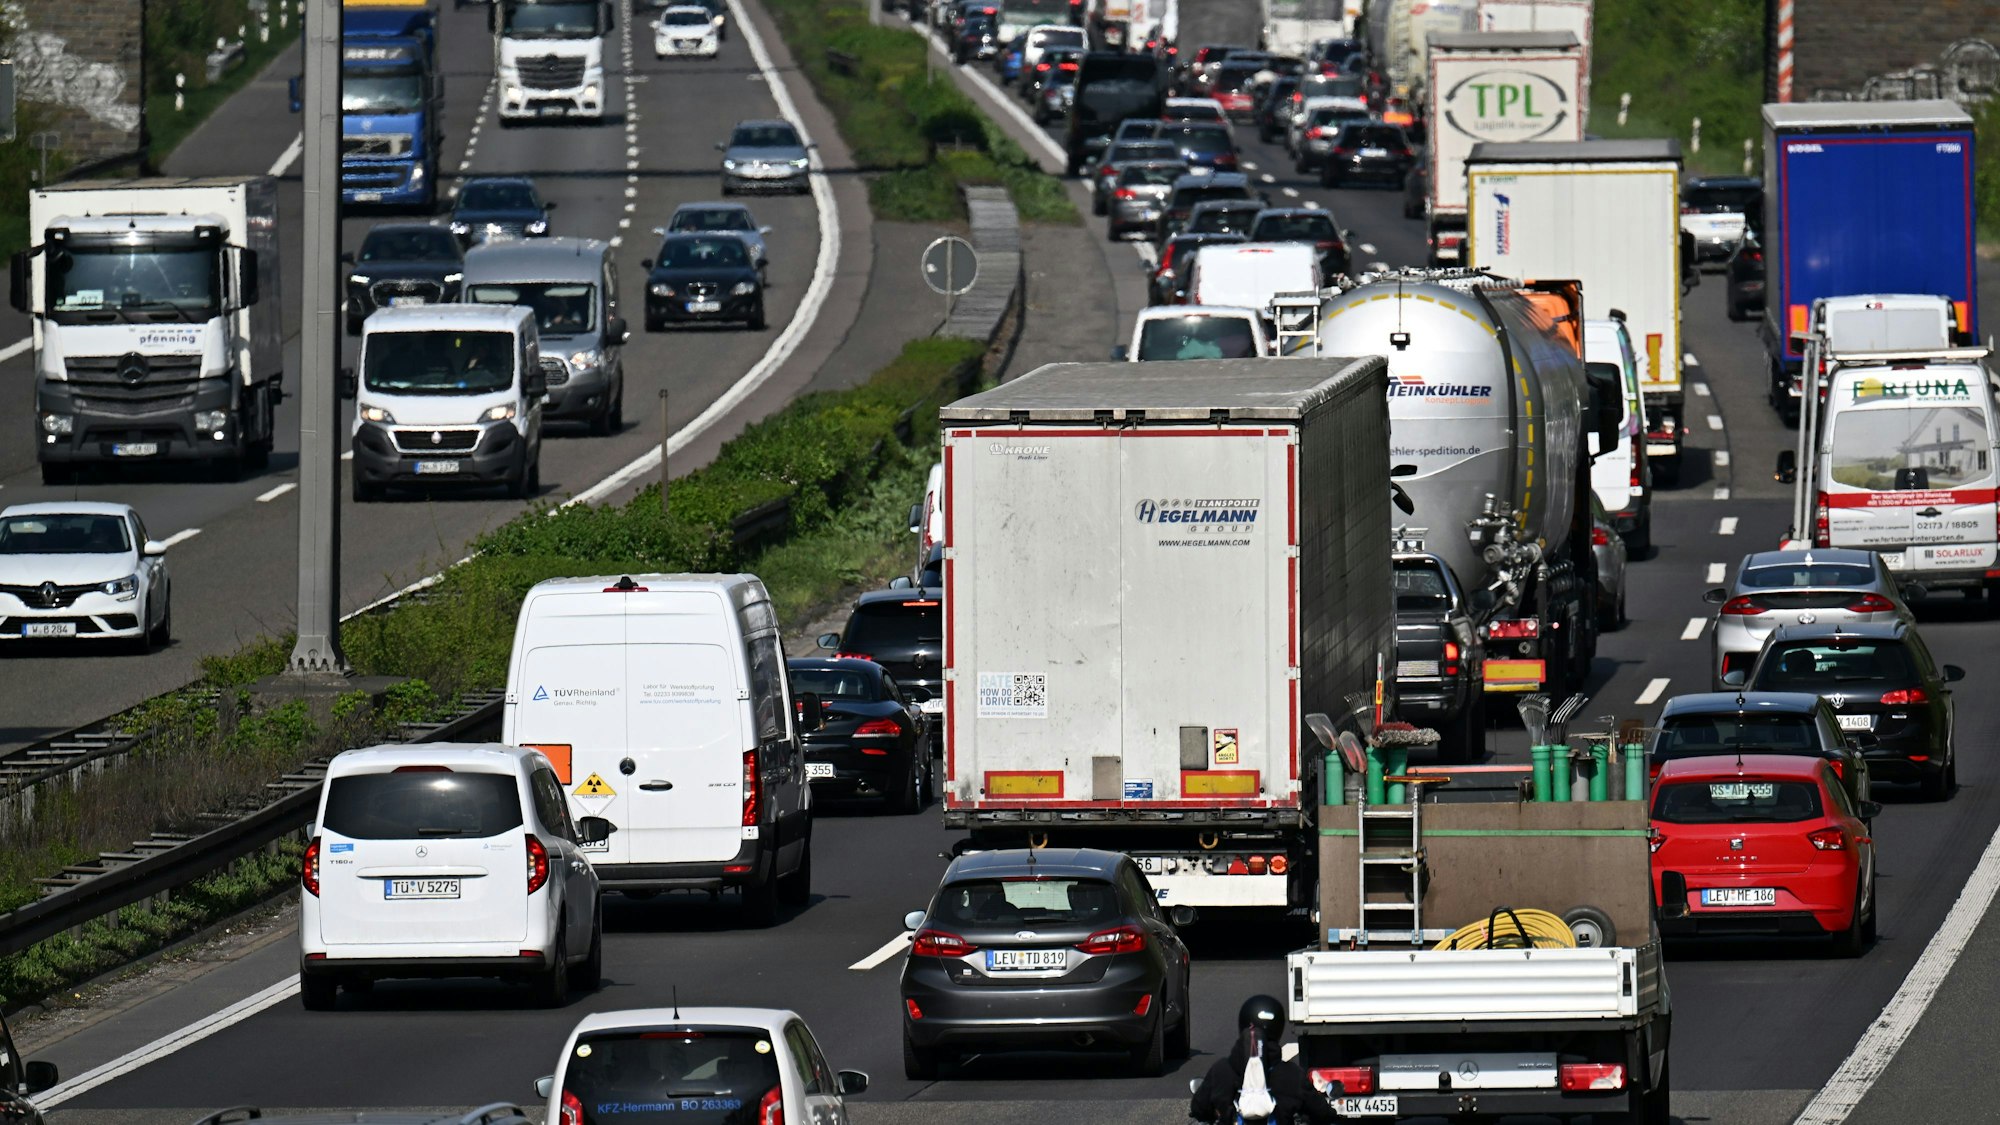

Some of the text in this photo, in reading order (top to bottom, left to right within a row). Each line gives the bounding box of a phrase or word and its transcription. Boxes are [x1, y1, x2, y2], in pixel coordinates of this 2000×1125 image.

[1468, 84, 1543, 118] TPL
[1389, 382, 1492, 397] TEINKÜHLER
[1004, 446, 1051, 455] KRONE
[1917, 522, 1943, 530] 02173
[1951, 521, 1979, 529] 18805
[1158, 539, 1250, 547] WWW.HEGELMANN.COM
[1936, 548, 1983, 558] SOLARLUX
[981, 675, 1012, 688] RATE
[980, 689, 1012, 697] HOW DO
[985, 697, 1012, 706] DRIVE
[1845, 716, 1869, 727] 1408
[811, 765, 832, 776] 355
[1711, 785, 1725, 795] RS
[1731, 785, 1745, 795] AH
[1137, 858, 1152, 870] 56
[393, 880, 458, 893] TÜ V 5275
[1709, 888, 1774, 902] LEV ME 186
[994, 952, 1065, 965] LEV TD 819
[597, 1099, 741, 1114] KFZ-Herrmann BO 263363
[1346, 1099, 1362, 1113] GK
[1364, 1098, 1396, 1112] 4455
